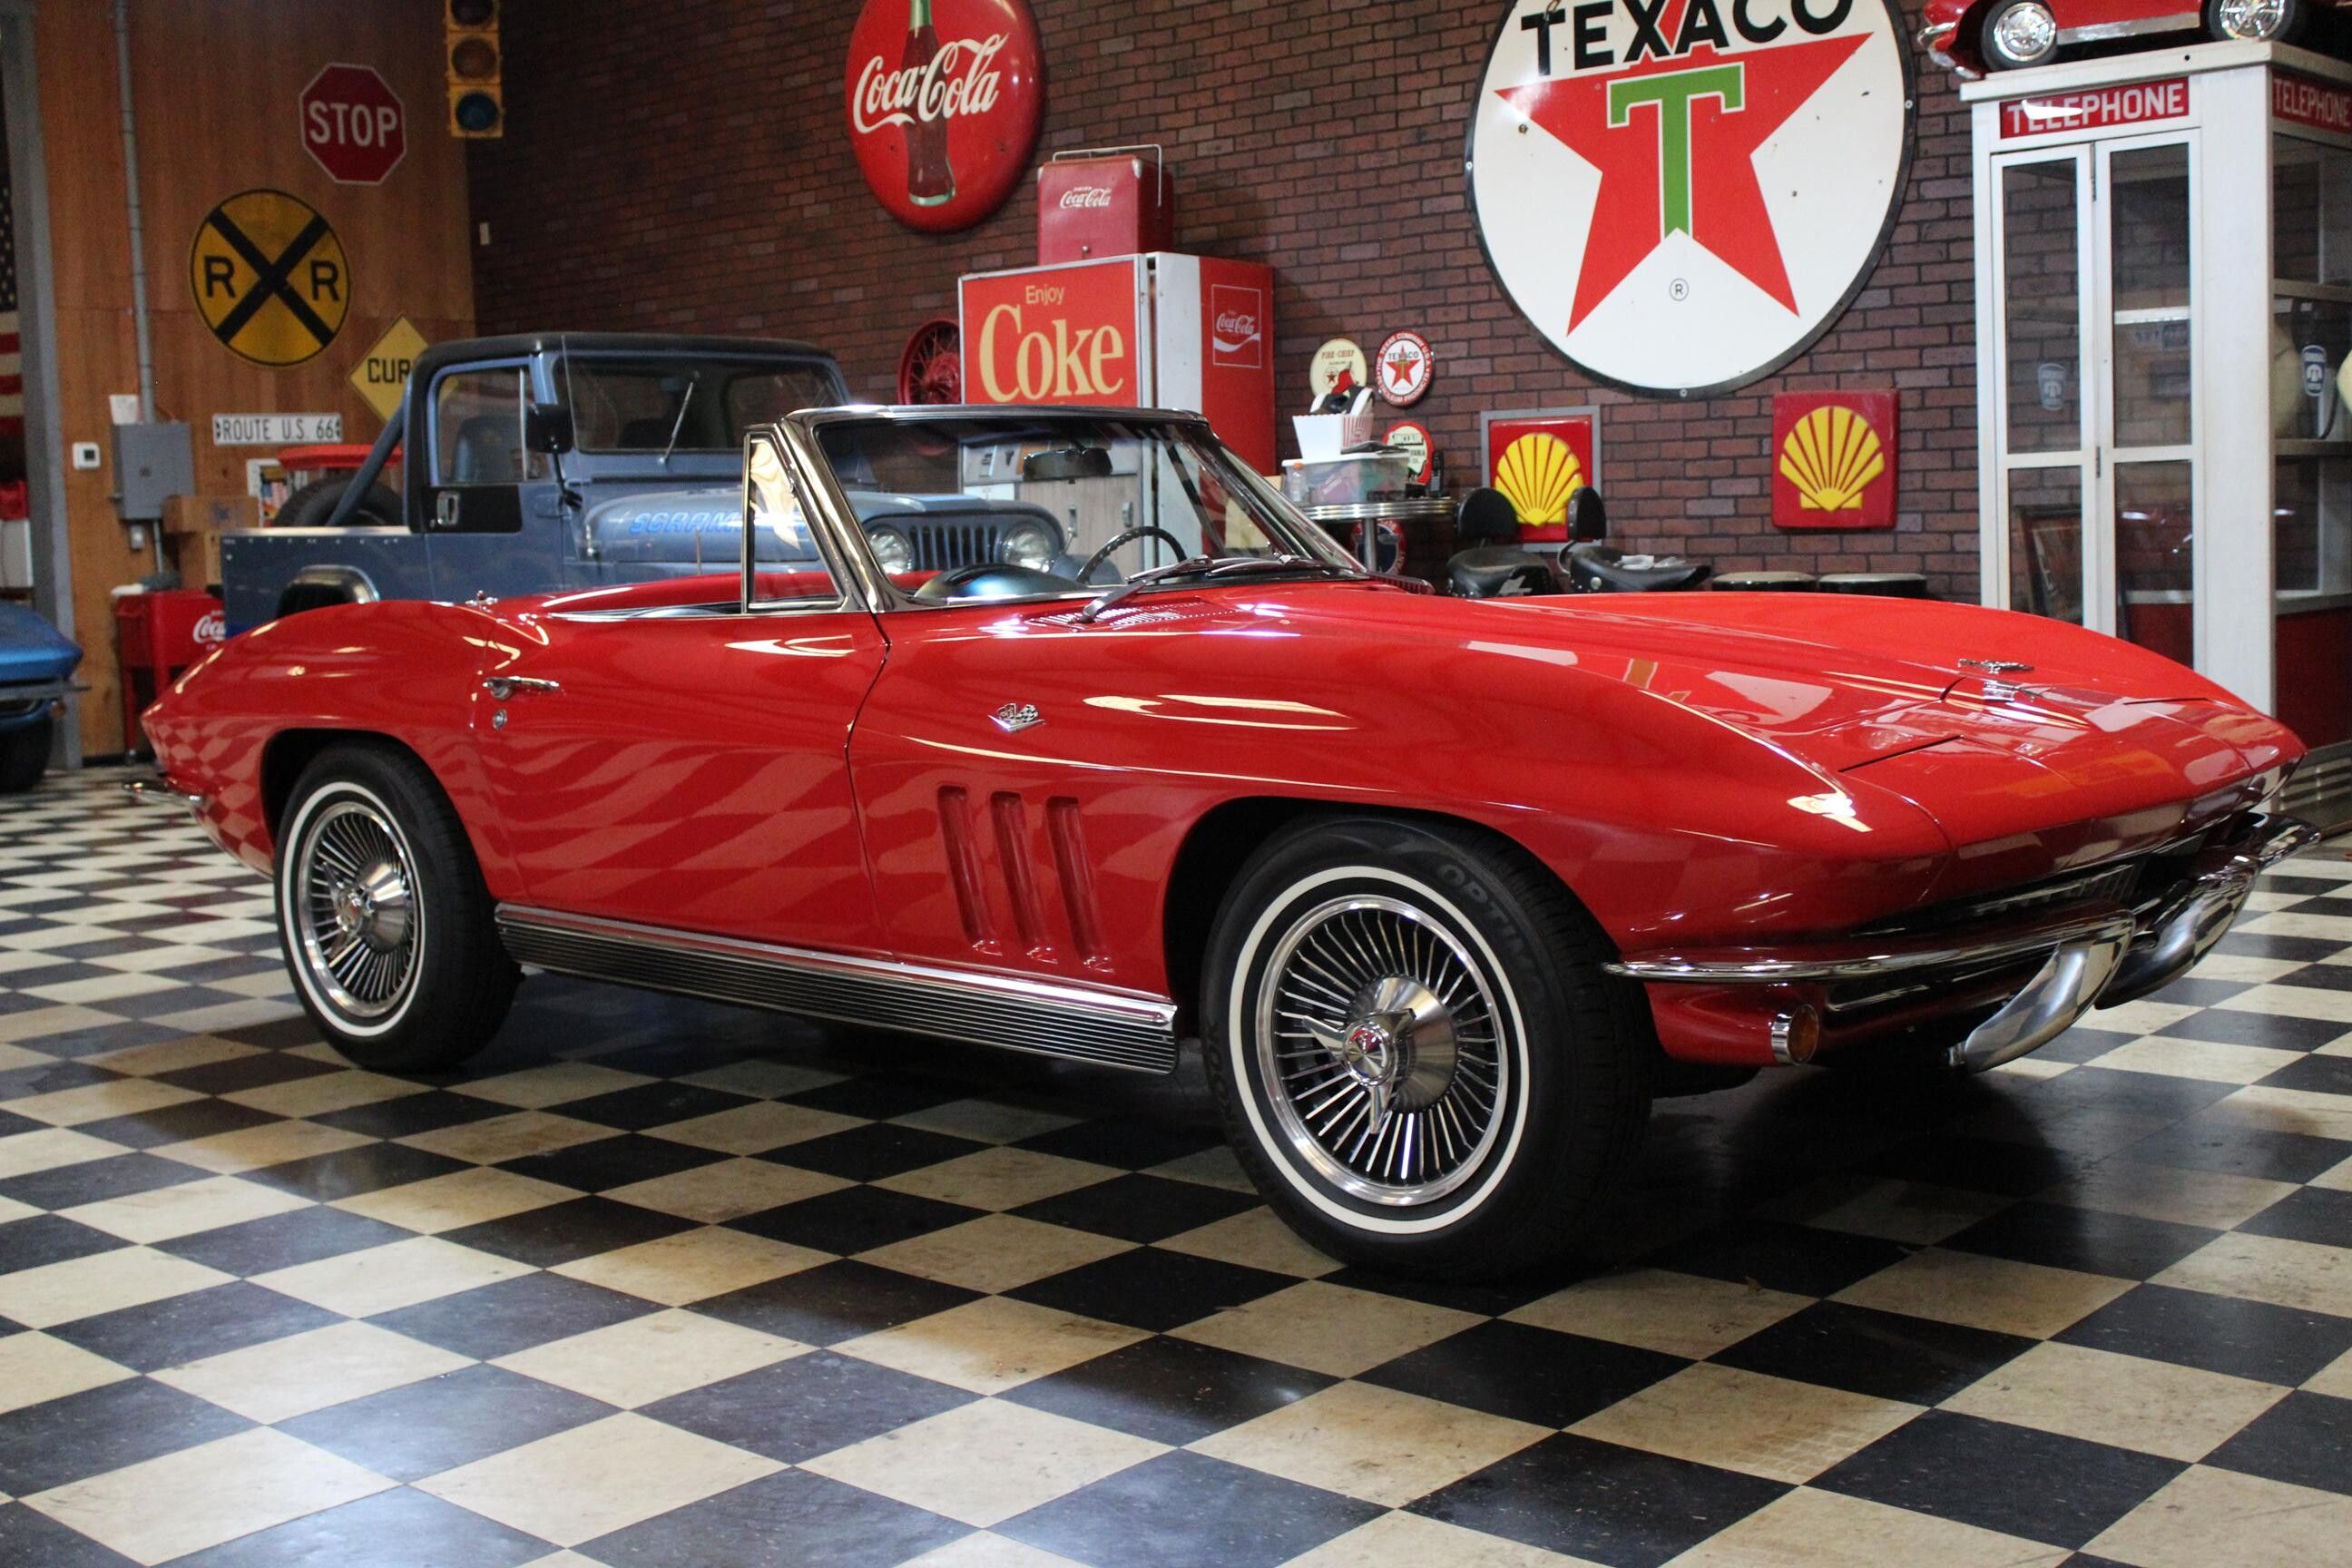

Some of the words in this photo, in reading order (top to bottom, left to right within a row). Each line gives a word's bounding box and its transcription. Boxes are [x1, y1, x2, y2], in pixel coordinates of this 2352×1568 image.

[852, 33, 1009, 133] Coca-Cola
[2273, 78, 2351, 127] TELEPHONE
[308, 101, 398, 148] STOP
[2006, 83, 2184, 134] TELEPHONE
[1059, 187, 1112, 210] Coca-Cola
[206, 256, 235, 297] R
[310, 260, 339, 301] R
[1025, 284, 1064, 305] Enjoy
[1216, 313, 1256, 335] Coca-Cola
[368, 358, 411, 383] CUR
[979, 304, 1124, 403] Coke
[223, 418, 270, 440] ROUTE
[316, 417, 334, 439] 66
